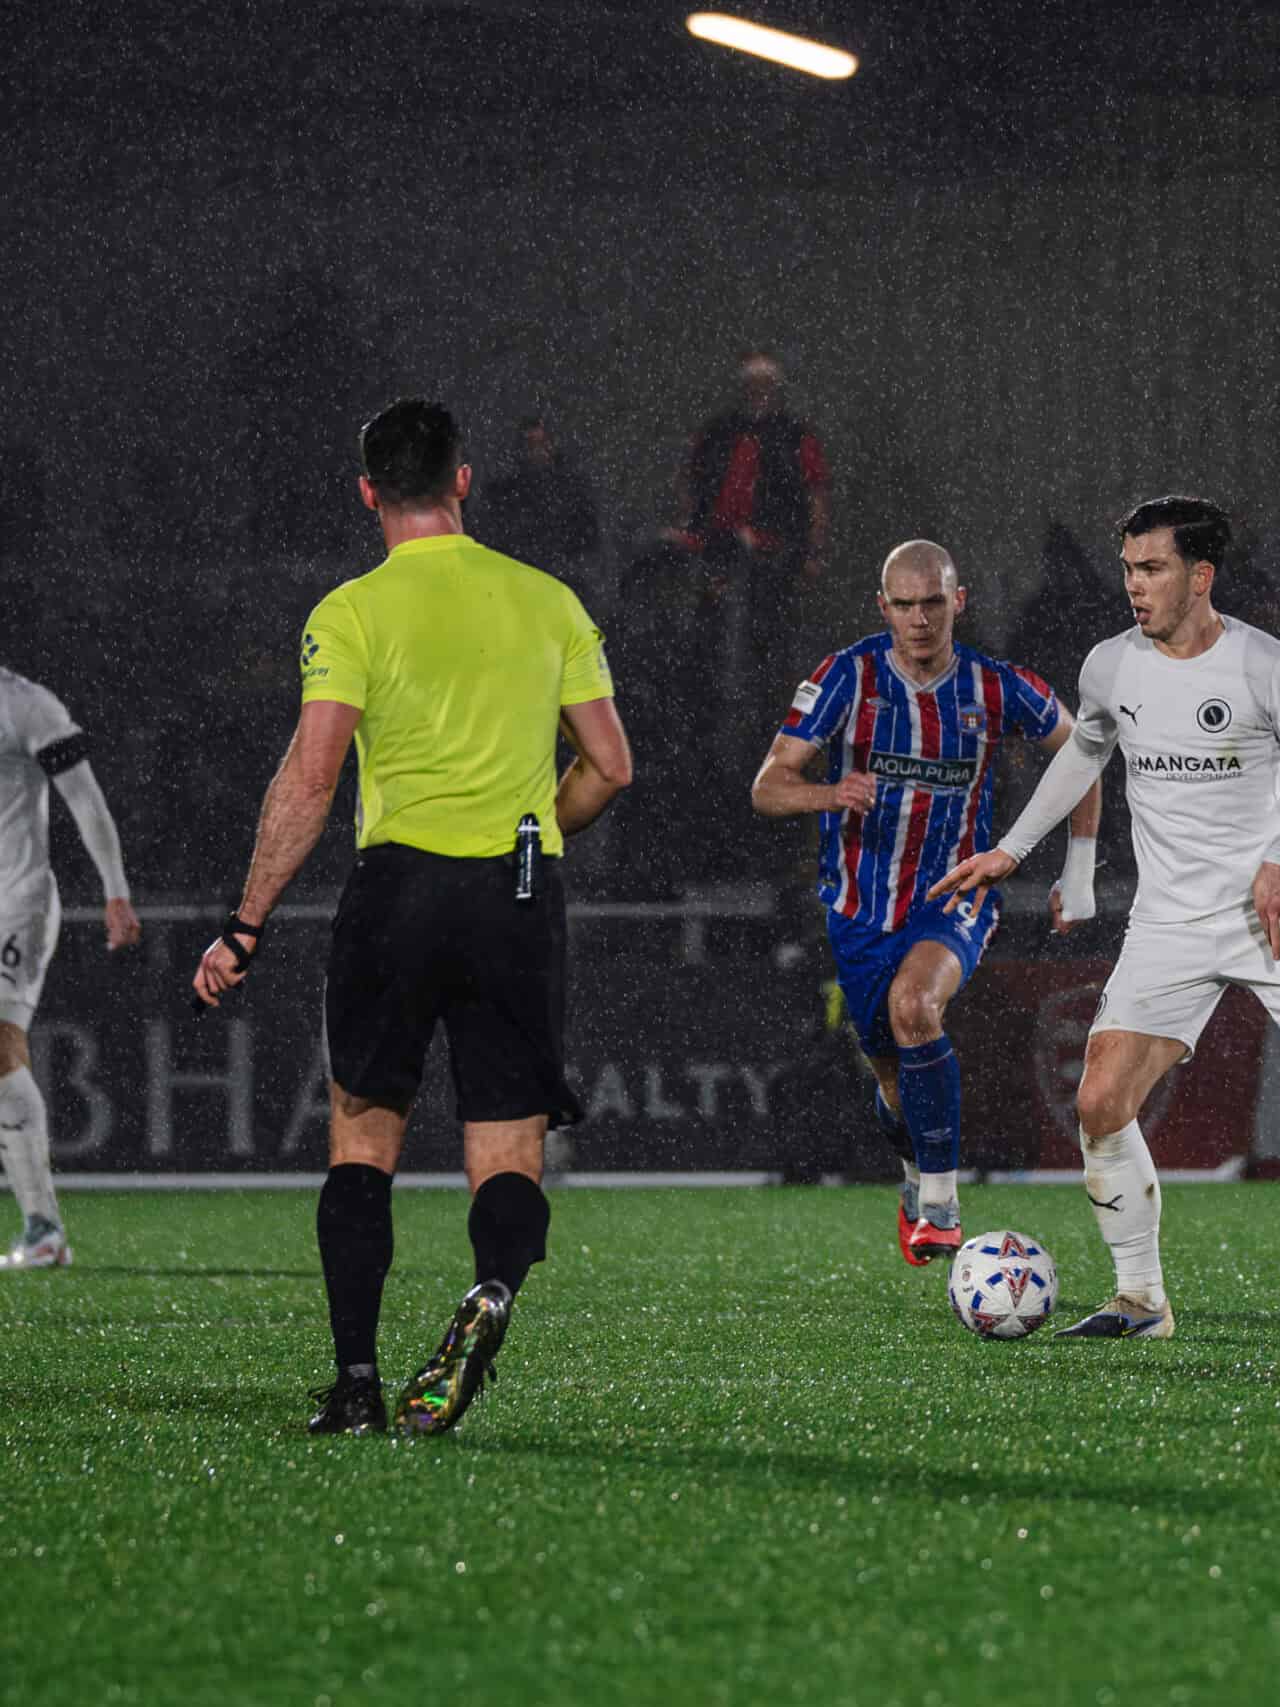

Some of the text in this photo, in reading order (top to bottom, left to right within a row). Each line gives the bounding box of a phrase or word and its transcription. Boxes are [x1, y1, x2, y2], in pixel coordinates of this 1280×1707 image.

[873, 757, 970, 783] AQUA PURA
[1138, 756, 1241, 772] MANGATA
